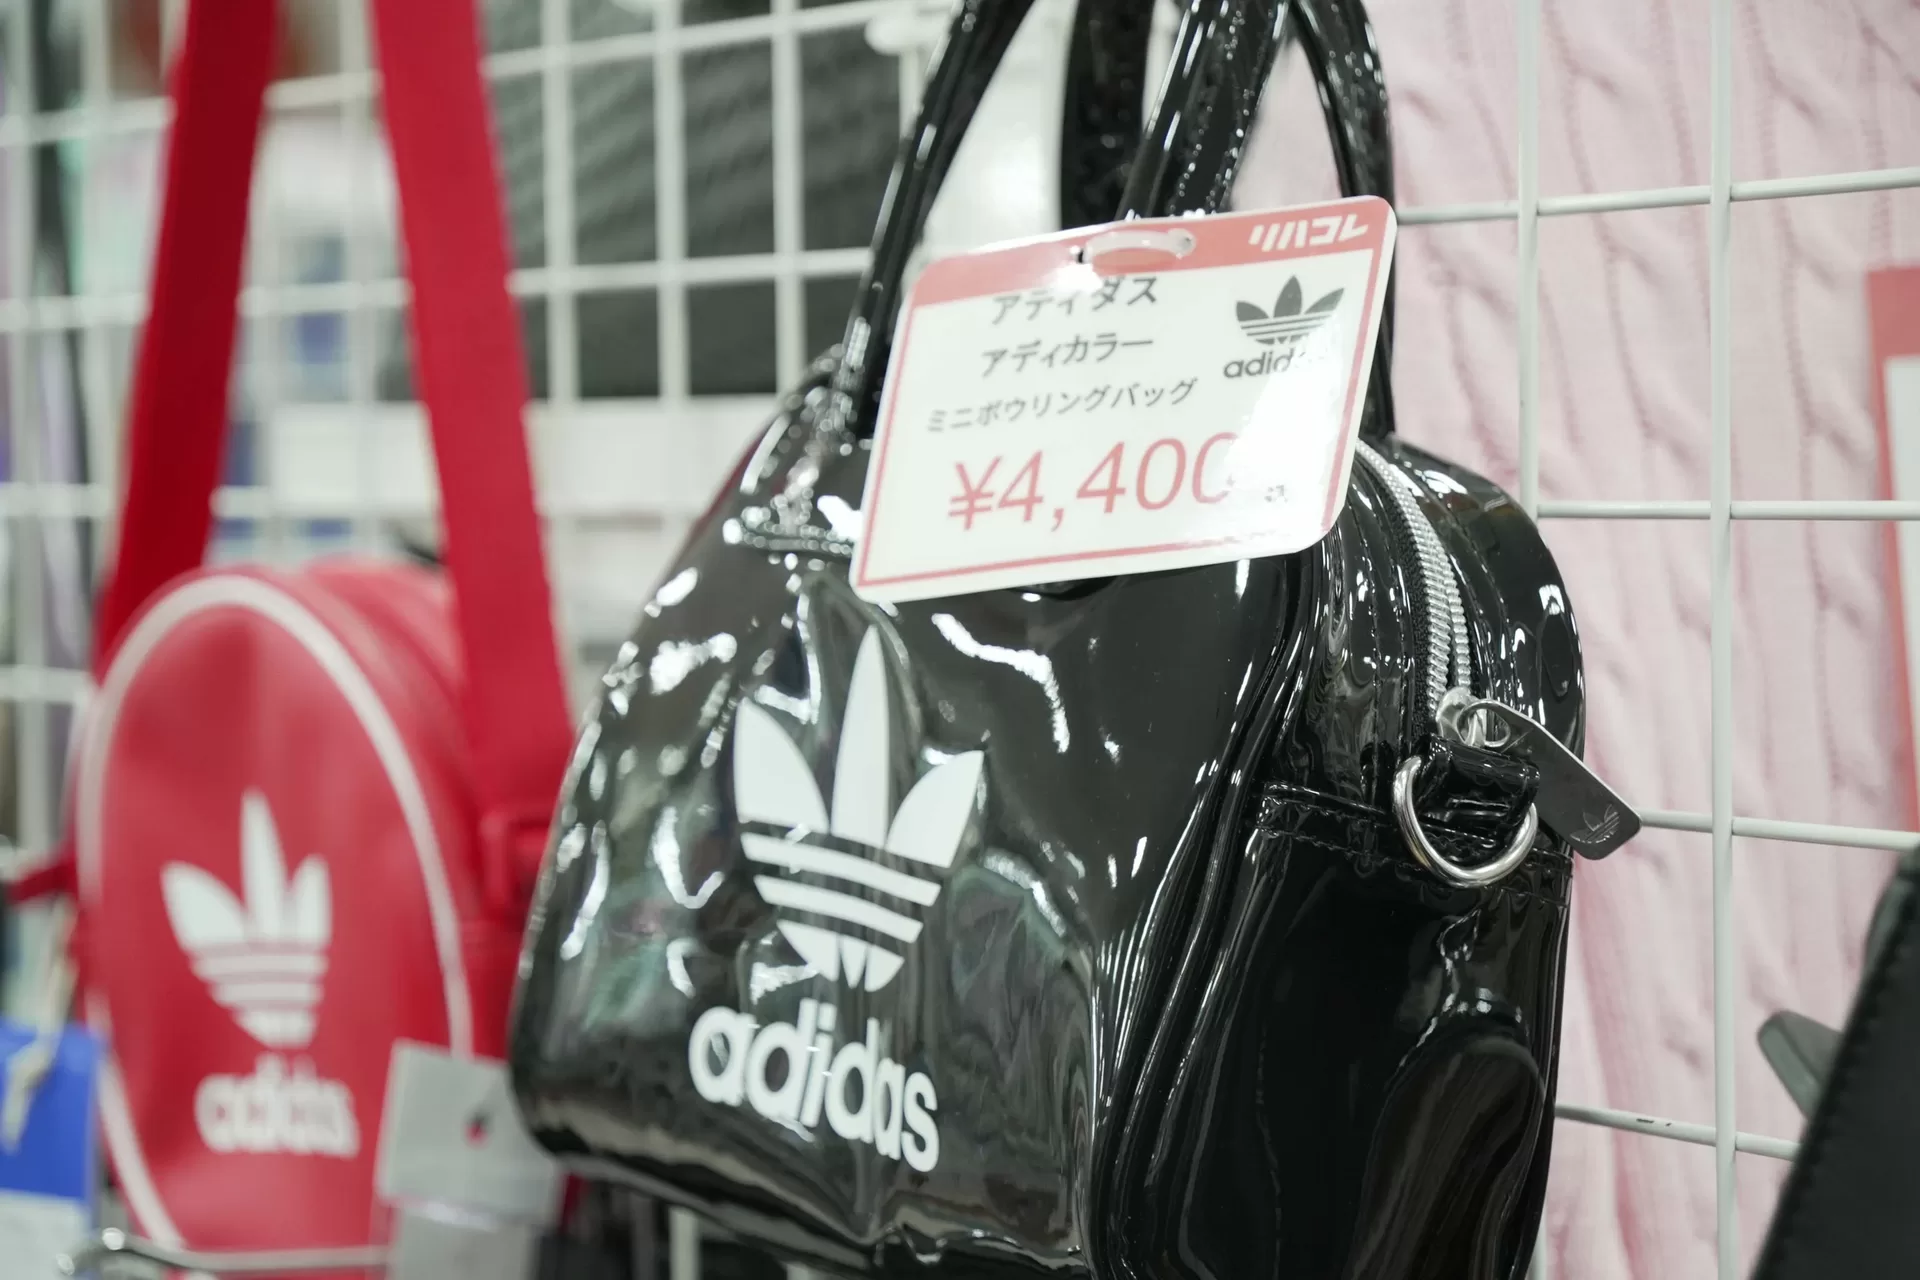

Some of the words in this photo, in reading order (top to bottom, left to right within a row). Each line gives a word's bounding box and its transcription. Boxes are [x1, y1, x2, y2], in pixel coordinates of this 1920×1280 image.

[982, 333, 1154, 378] アディカラー
[1223, 344, 1308, 379] adid
[948, 431, 1238, 532] ¥4,400
[689, 998, 940, 1172] adidas
